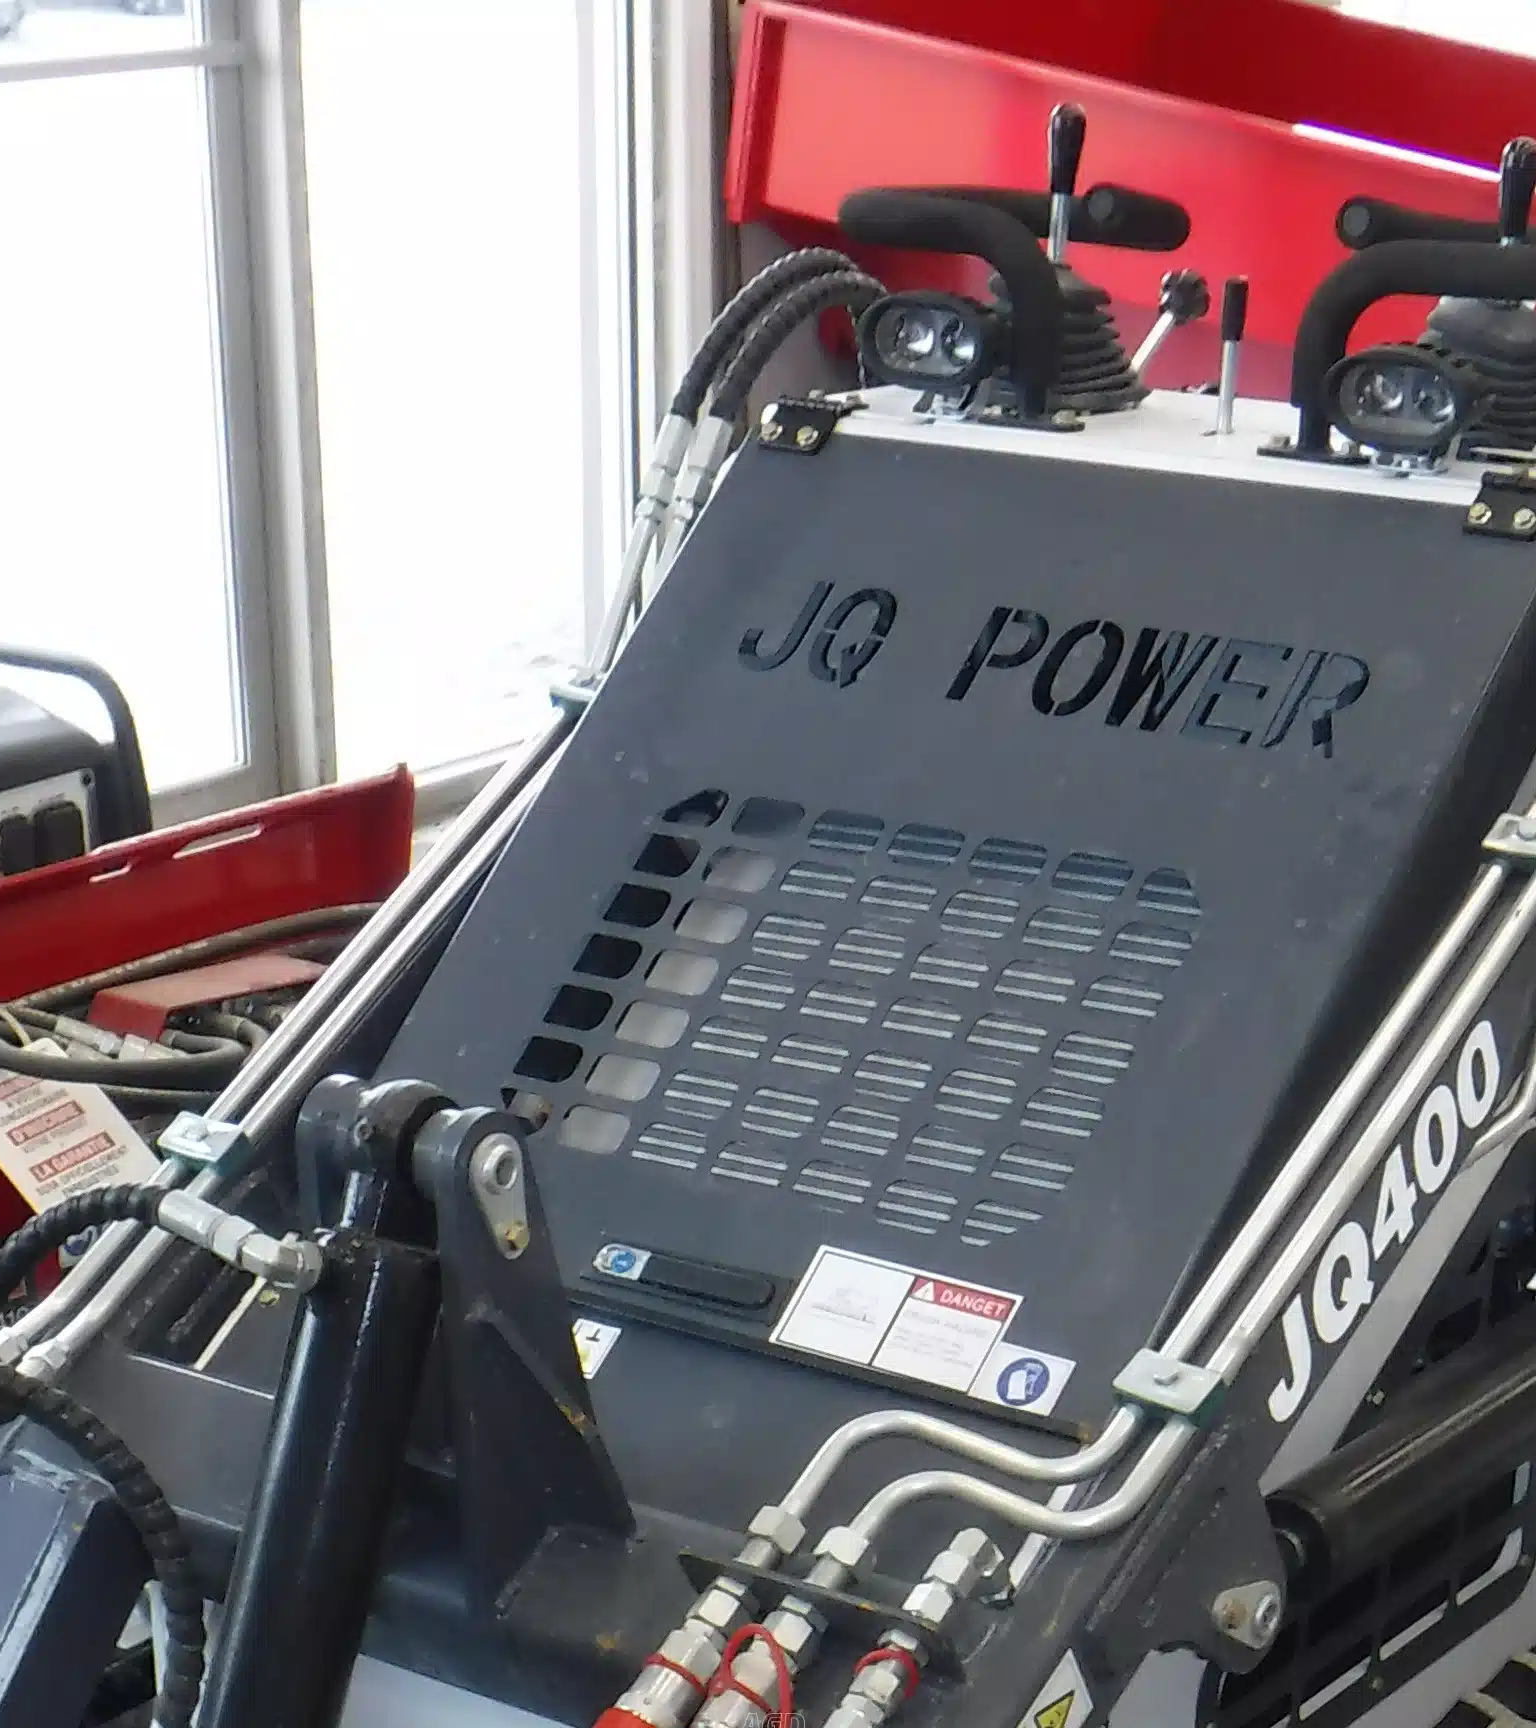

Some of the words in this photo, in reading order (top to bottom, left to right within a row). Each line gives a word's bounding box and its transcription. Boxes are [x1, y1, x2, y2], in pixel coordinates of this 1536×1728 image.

[738, 580, 898, 690] JQ
[945, 605, 1371, 758] POWER
[34, 1162, 57, 1181] LA
[52, 1136, 112, 1173] GARANTIE
[1267, 1020, 1501, 1423] JQ400
[939, 1288, 1008, 1318] DANGET
